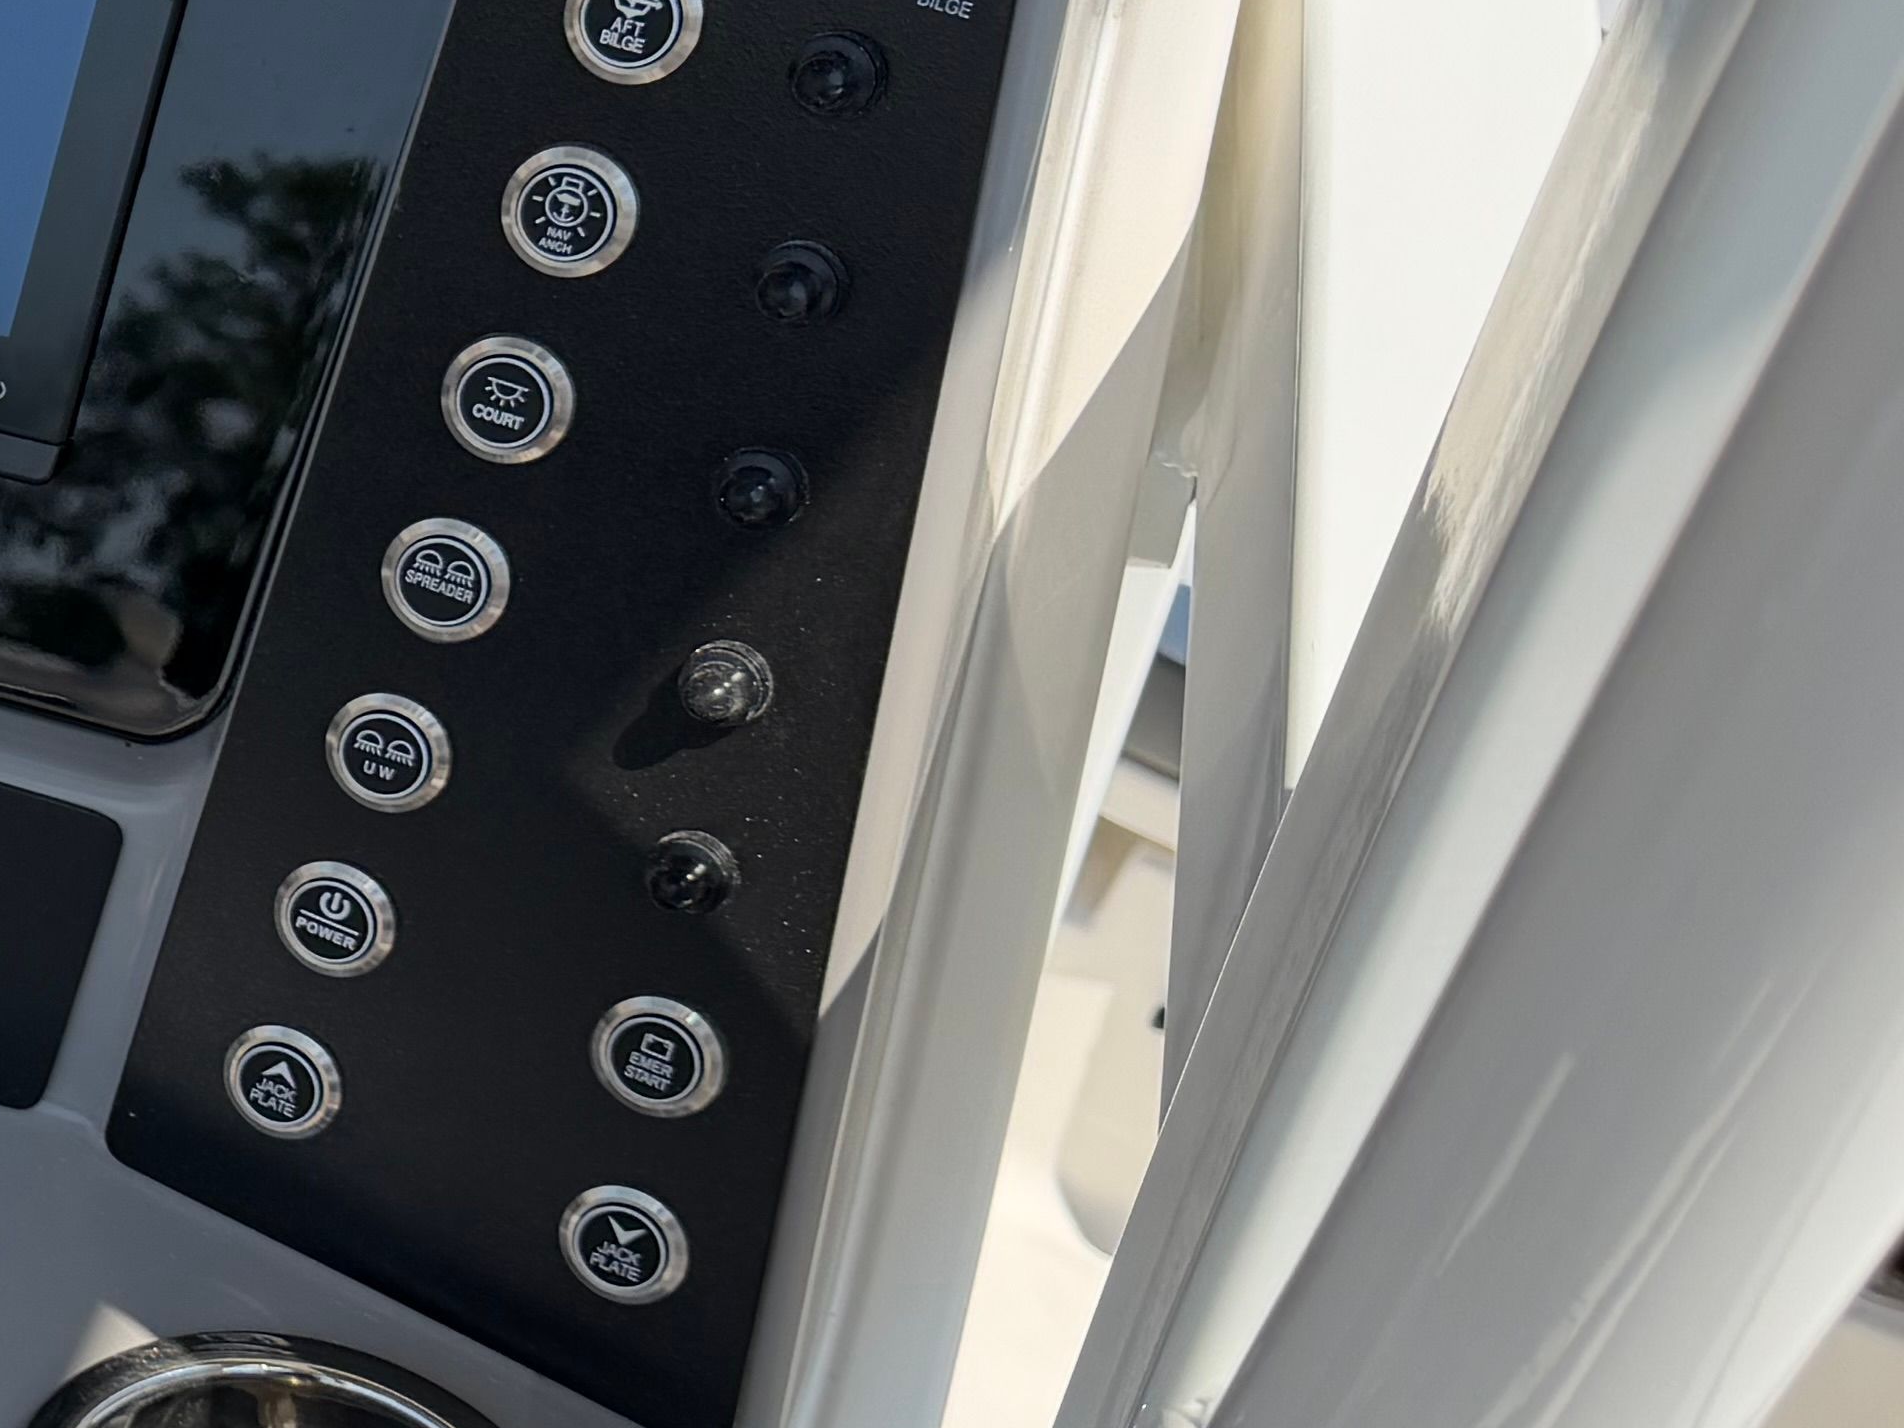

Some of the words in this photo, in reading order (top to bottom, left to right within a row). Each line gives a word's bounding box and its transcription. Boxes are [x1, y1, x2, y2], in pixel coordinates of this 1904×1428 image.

[610, 18, 645, 37] AFT
[599, 29, 646, 54] BILGE
[538, 236, 573, 255] ANCH
[546, 226, 572, 242] NAV
[472, 403, 525, 430] COURT
[404, 568, 474, 605] SPREADER
[295, 916, 358, 951] POWER
[624, 1064, 672, 1091] START
[629, 1051, 673, 1079] EMER
[249, 1088, 297, 1118] PLATE
[255, 1078, 297, 1102] JACK
[590, 1252, 641, 1282] PLATE
[596, 1241, 642, 1266] JACK
